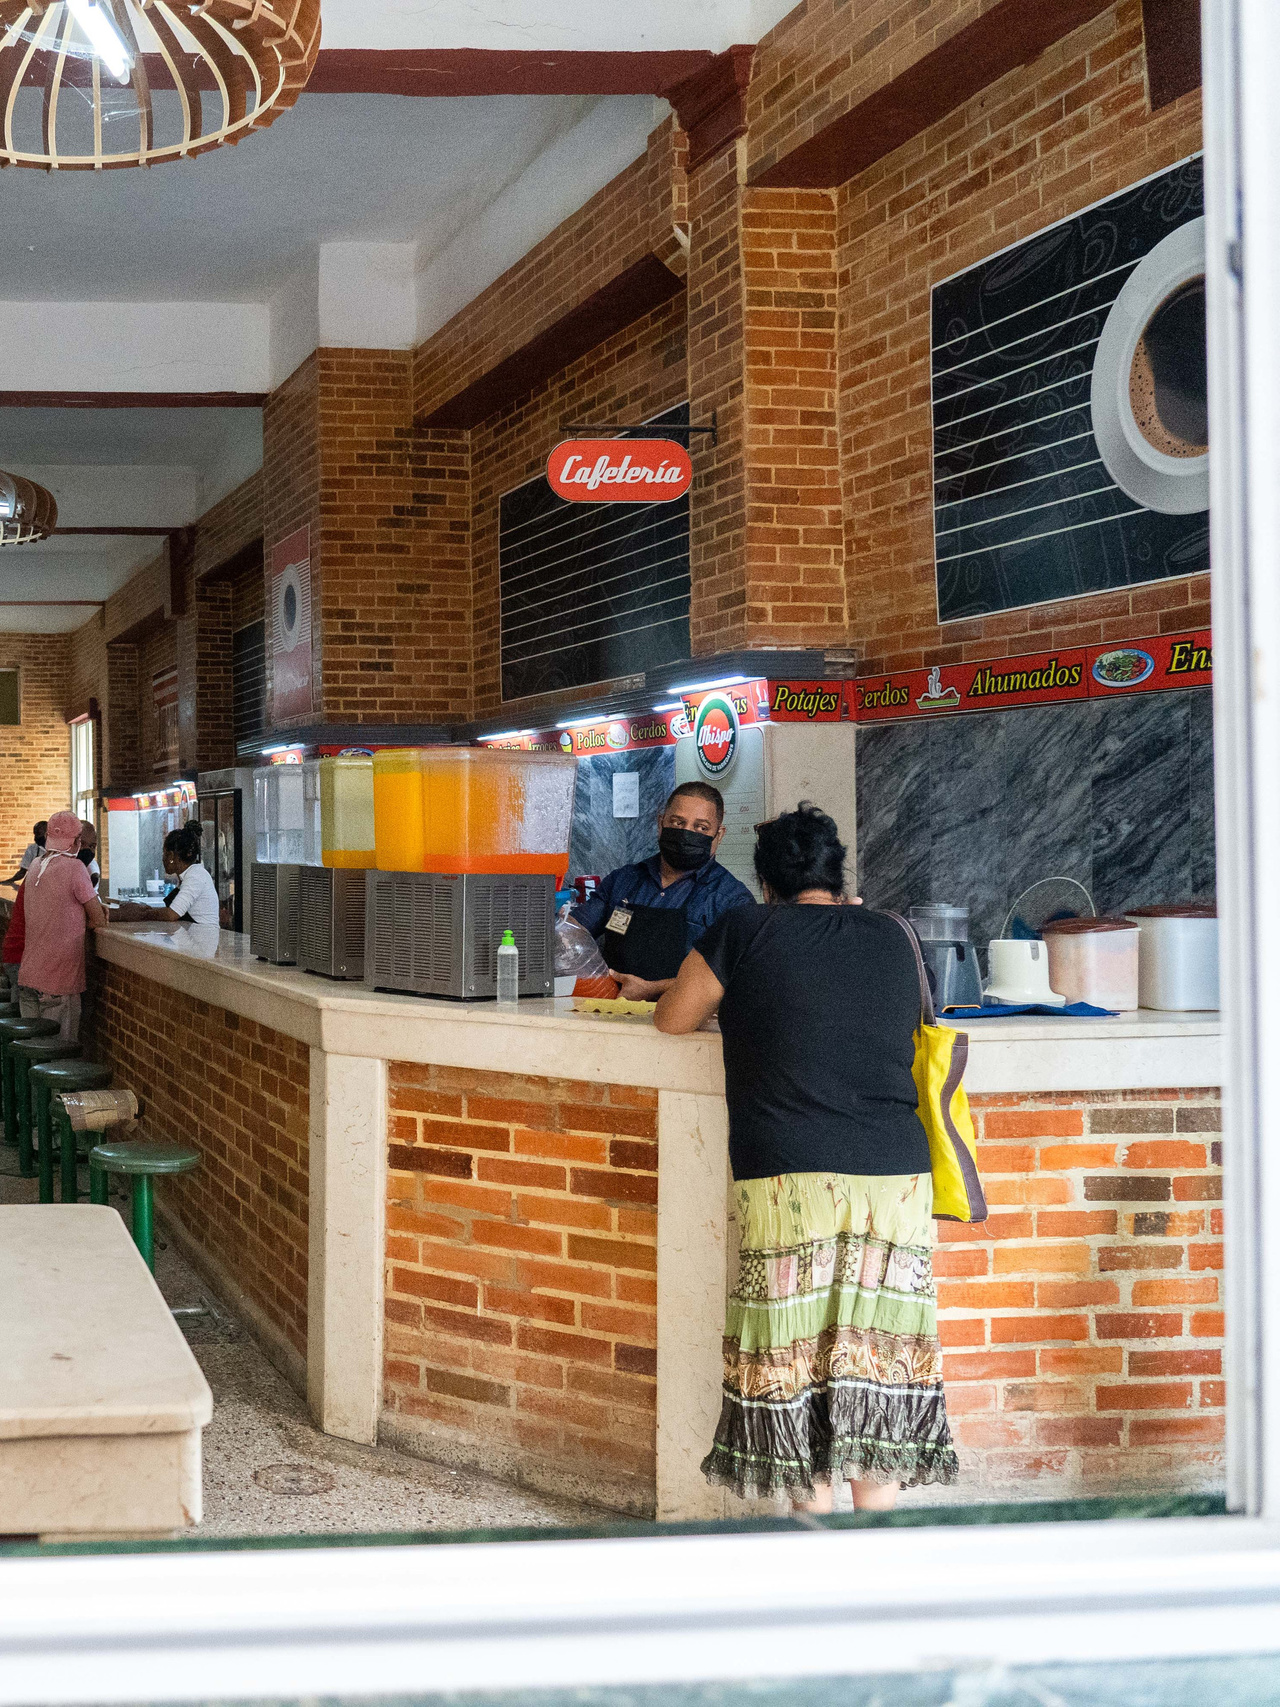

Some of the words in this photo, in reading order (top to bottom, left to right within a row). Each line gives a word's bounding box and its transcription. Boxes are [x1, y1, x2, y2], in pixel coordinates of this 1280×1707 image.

[559, 455, 684, 490] Cafetería
[969, 659, 1082, 696] Ahumados
[773, 687, 838, 717] Potajes
[577, 729, 606, 749] Pollos
[630, 721, 667, 741] Cerdos
[698, 724, 735, 748] Obispo
